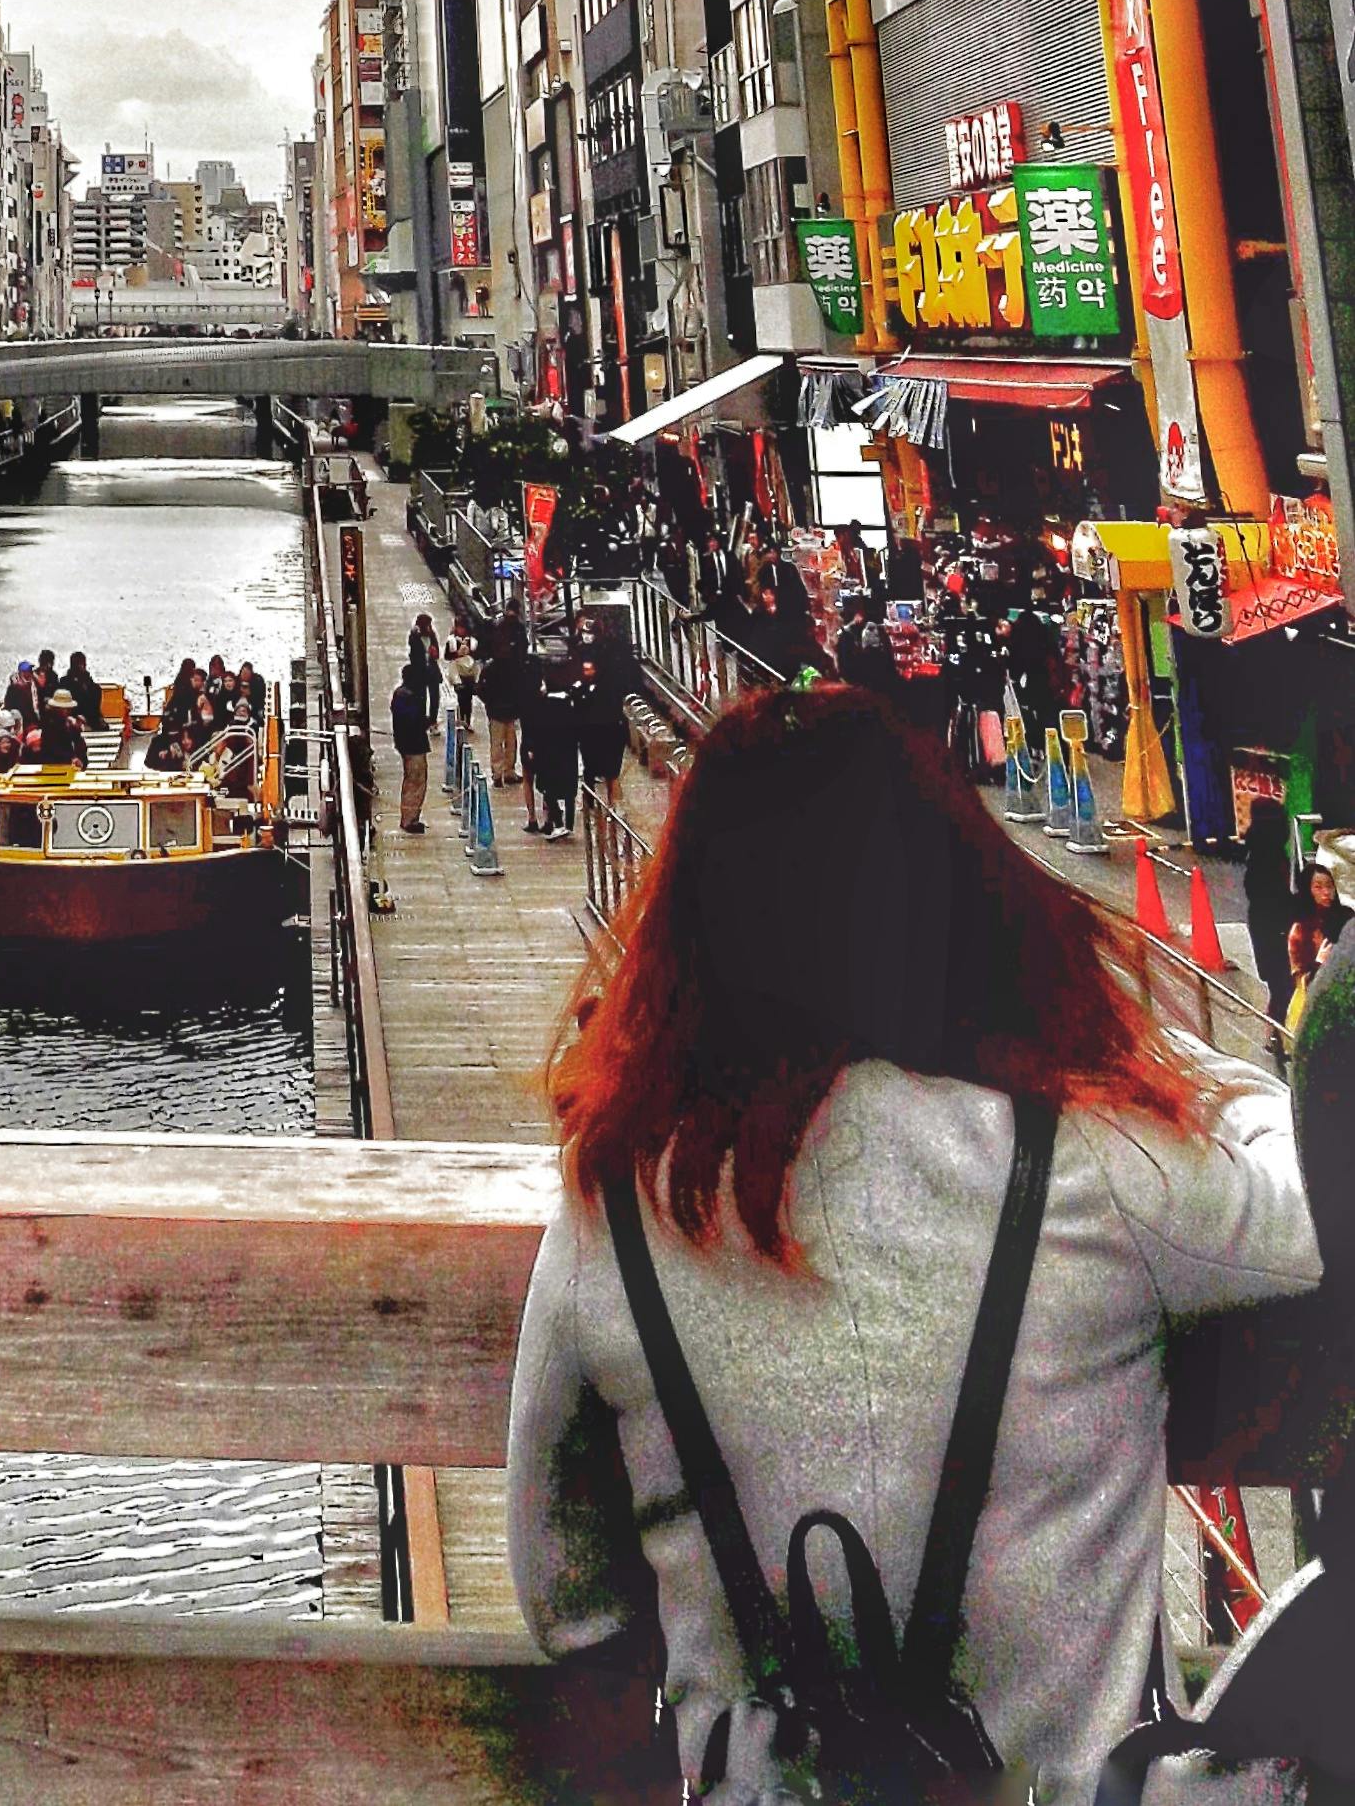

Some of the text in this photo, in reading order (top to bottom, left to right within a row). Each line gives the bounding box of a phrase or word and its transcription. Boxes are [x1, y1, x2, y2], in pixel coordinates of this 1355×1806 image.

[1024, 187, 1099, 255] 薬
[805, 235, 854, 280] 薬
[1032, 261, 1105, 273] Medicine
[1035, 278, 1067, 308] 药
[1076, 277, 1107, 309] 약
